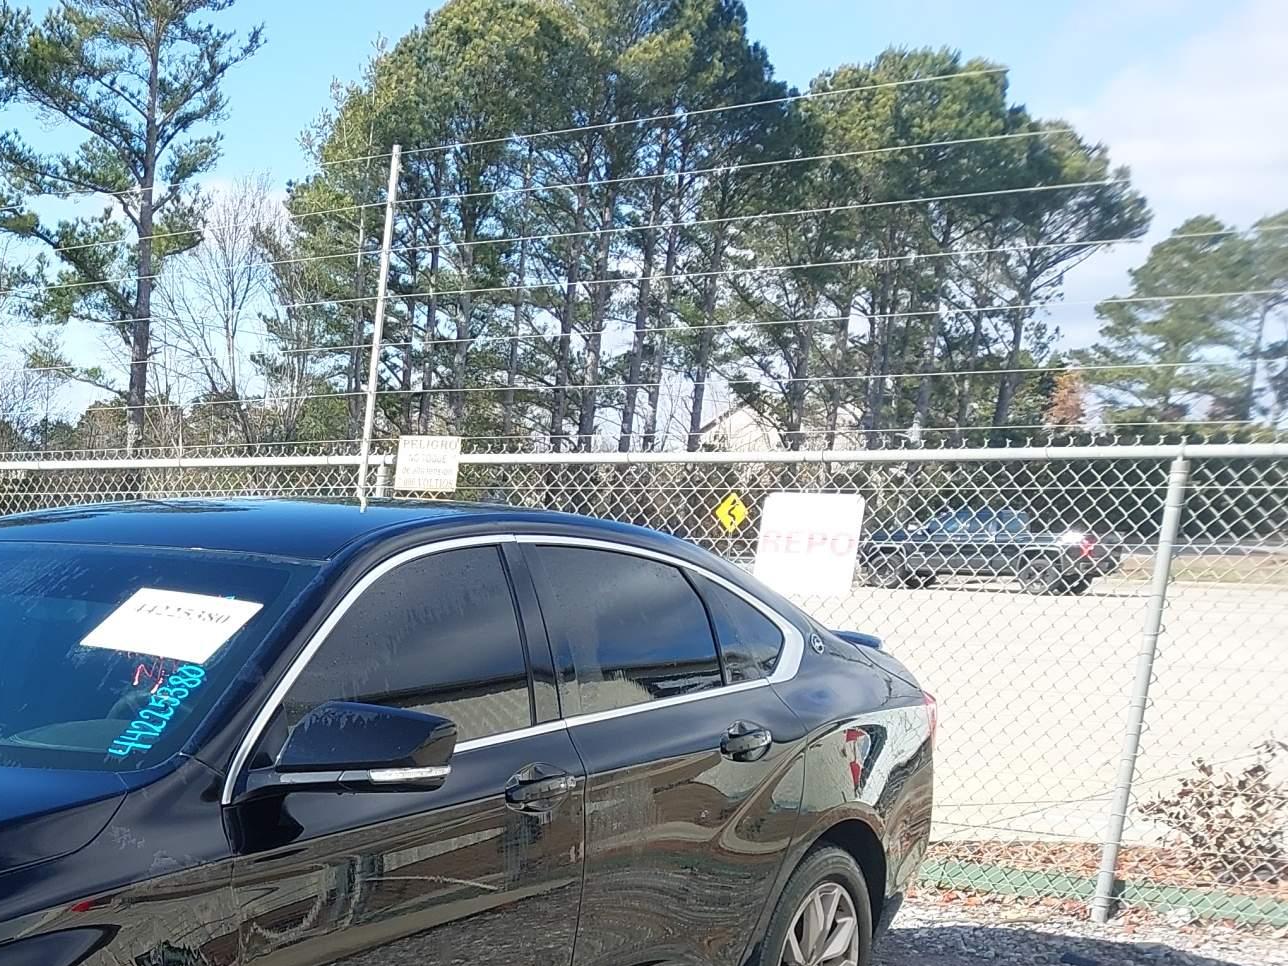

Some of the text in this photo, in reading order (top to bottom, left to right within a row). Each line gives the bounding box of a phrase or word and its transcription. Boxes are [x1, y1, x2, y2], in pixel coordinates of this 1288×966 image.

[403, 439, 458, 450] PELIGRO
[761, 528, 857, 558] REPO
[108, 664, 206, 756] 44225380
